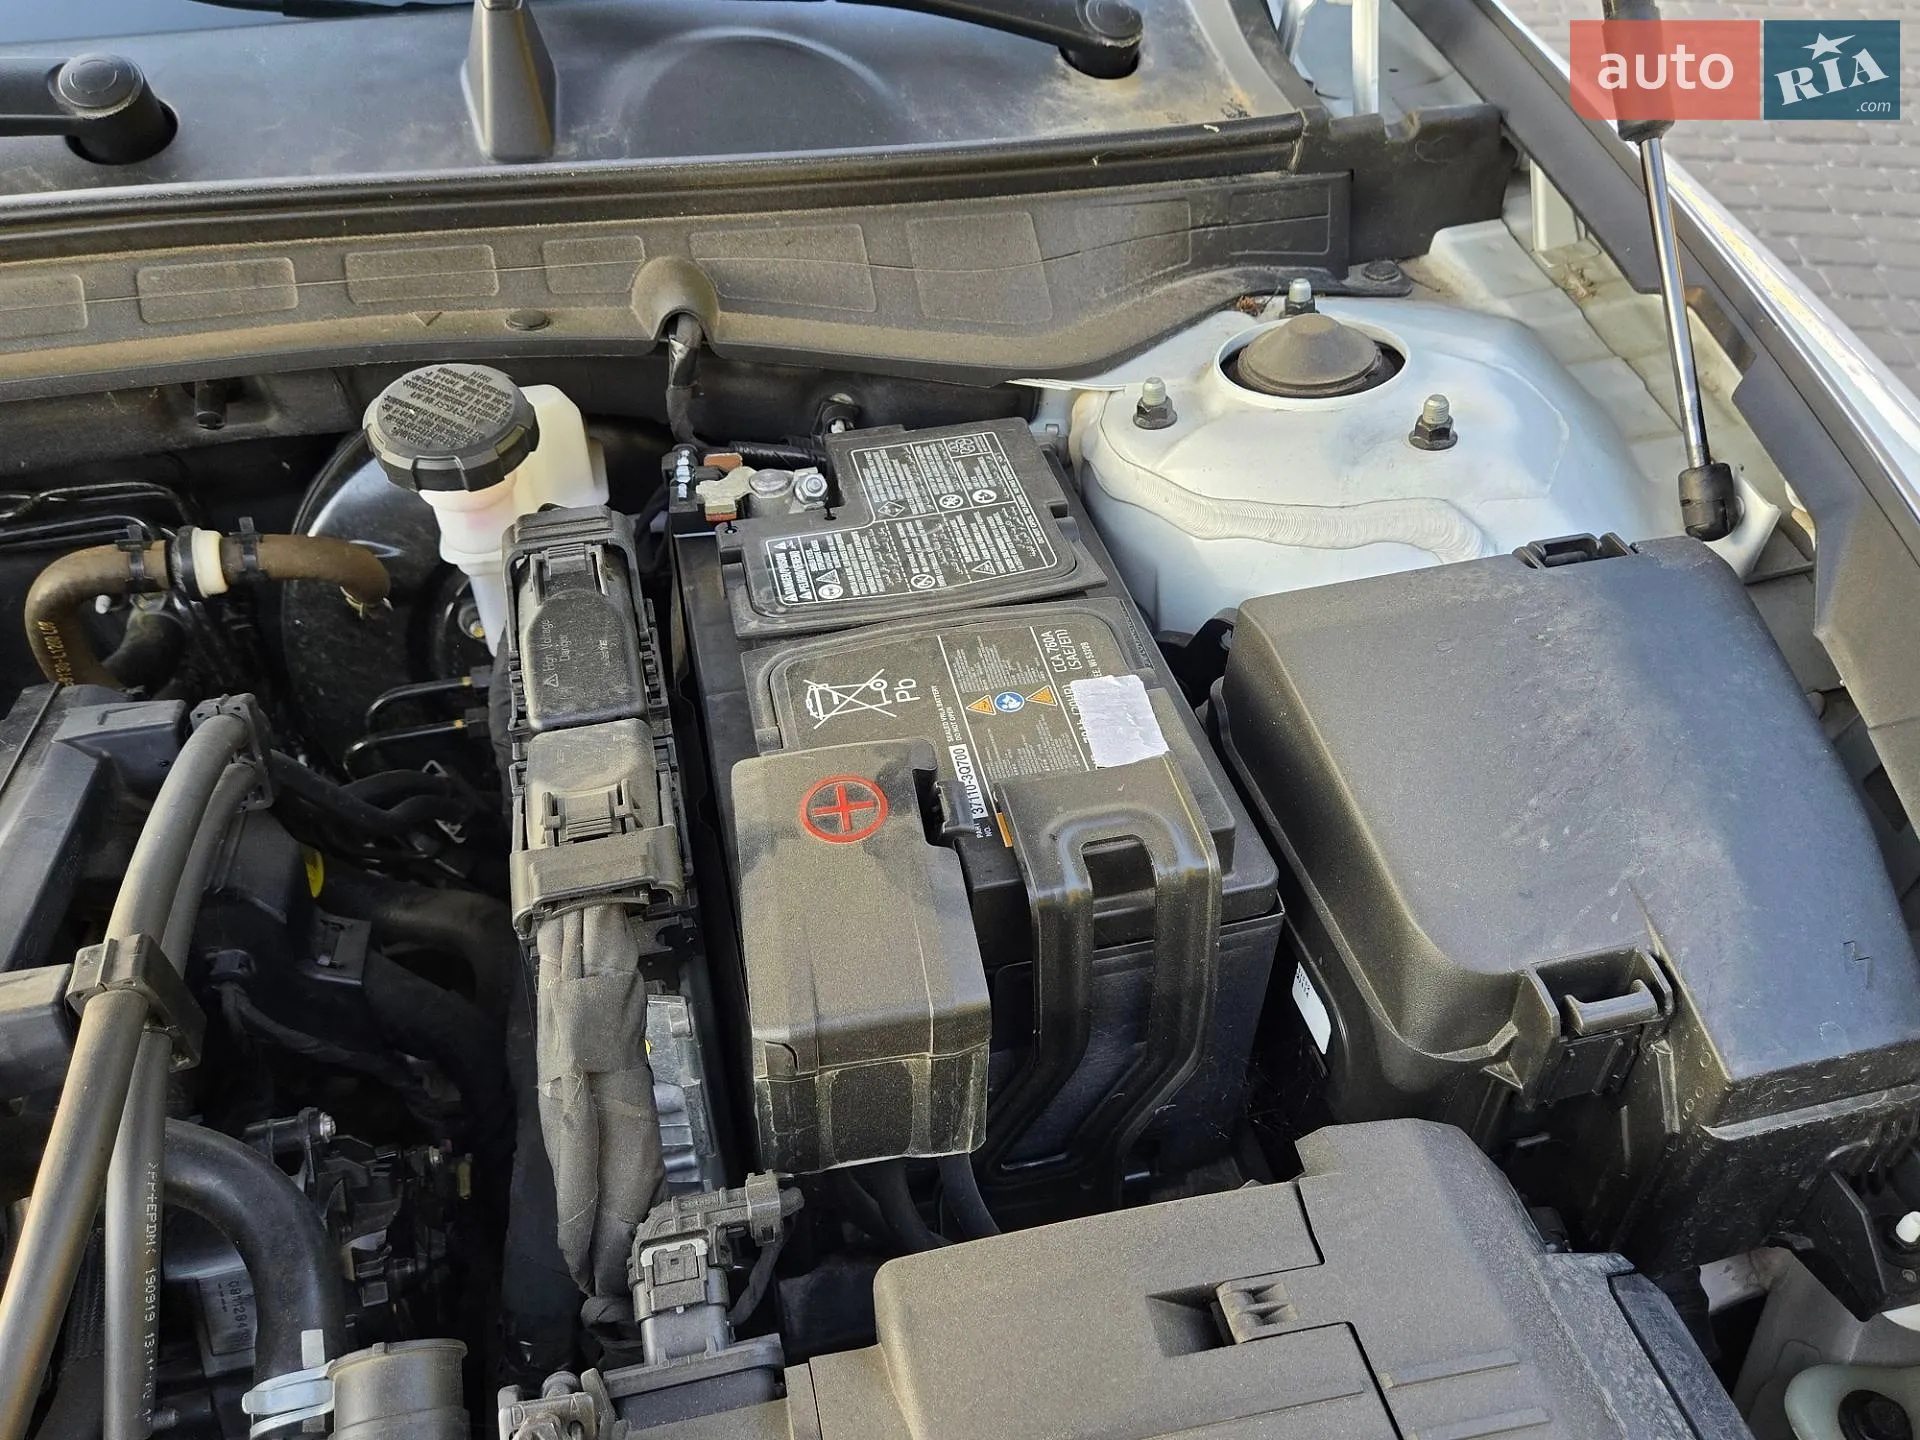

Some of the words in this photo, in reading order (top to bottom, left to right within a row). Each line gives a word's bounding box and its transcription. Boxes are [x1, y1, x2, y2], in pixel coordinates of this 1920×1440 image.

[1041, 630, 1059, 653] 760A
[1050, 653, 1067, 673] CCA
[893, 678, 921, 703] Pb
[952, 748, 984, 815] 37110-3Q700
